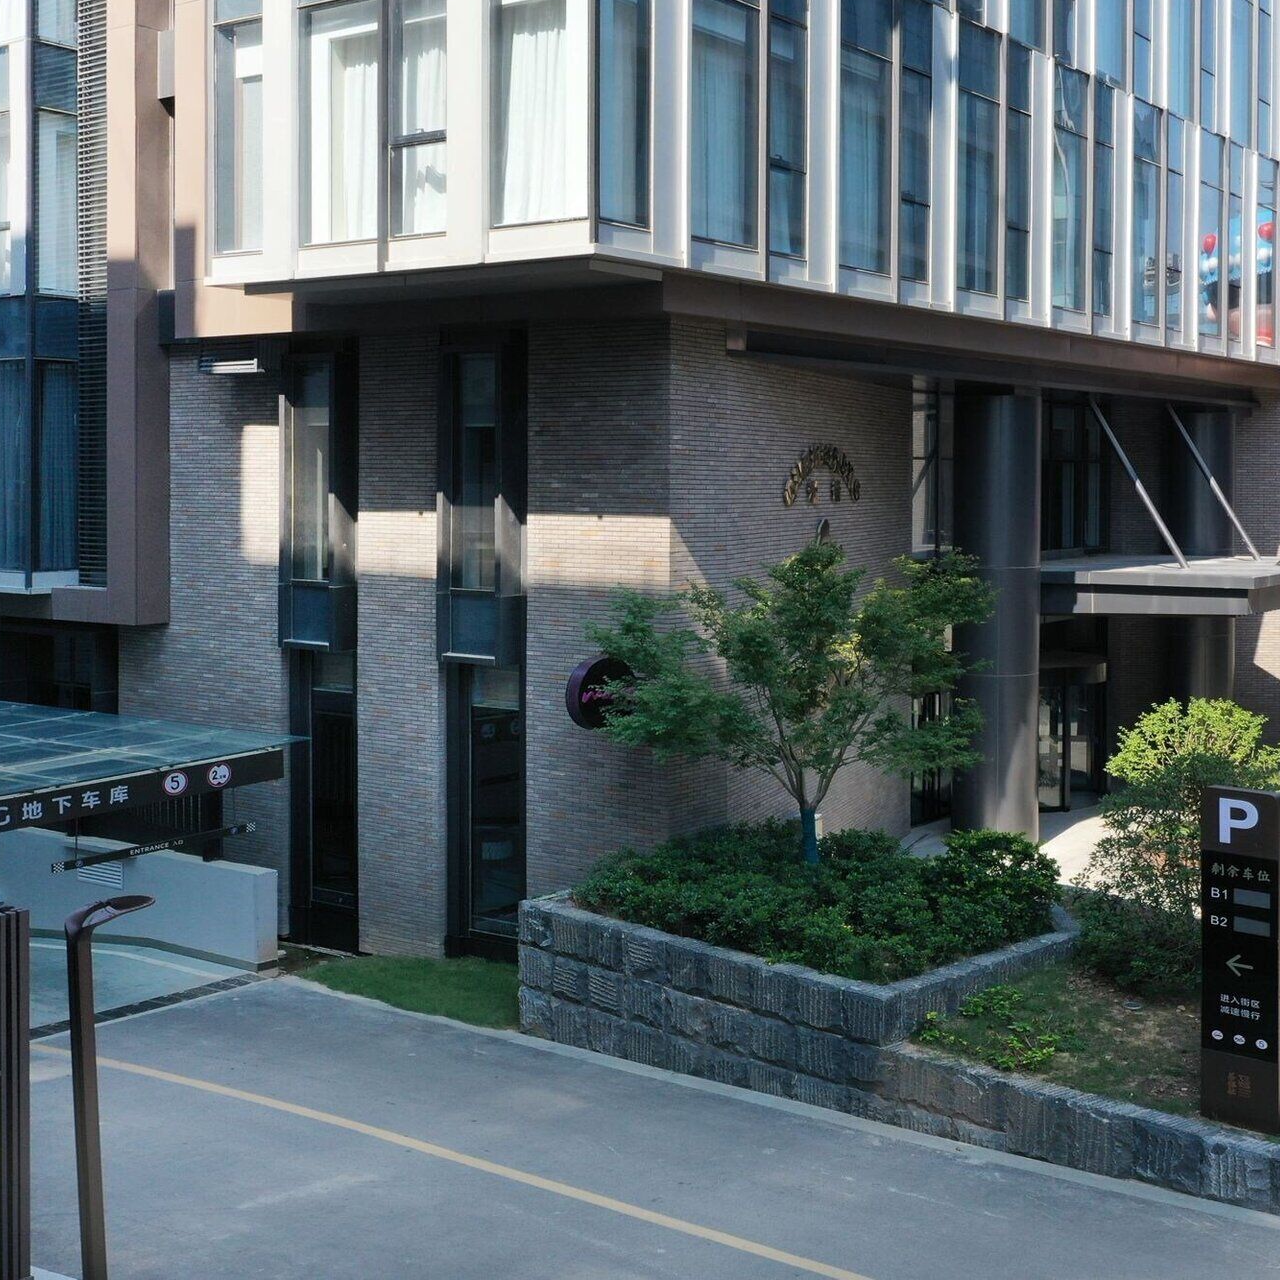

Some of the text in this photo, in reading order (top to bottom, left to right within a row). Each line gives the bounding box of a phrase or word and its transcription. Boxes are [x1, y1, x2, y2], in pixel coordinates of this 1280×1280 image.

[22, 785, 129, 820] 地下车库
[1219, 797, 1259, 844] P
[130, 842, 170, 856] ENTRANCE
[1211, 862, 1270, 882] 剩余车位
[1211, 887, 1228, 900] B1
[1210, 915, 1228, 927] B2
